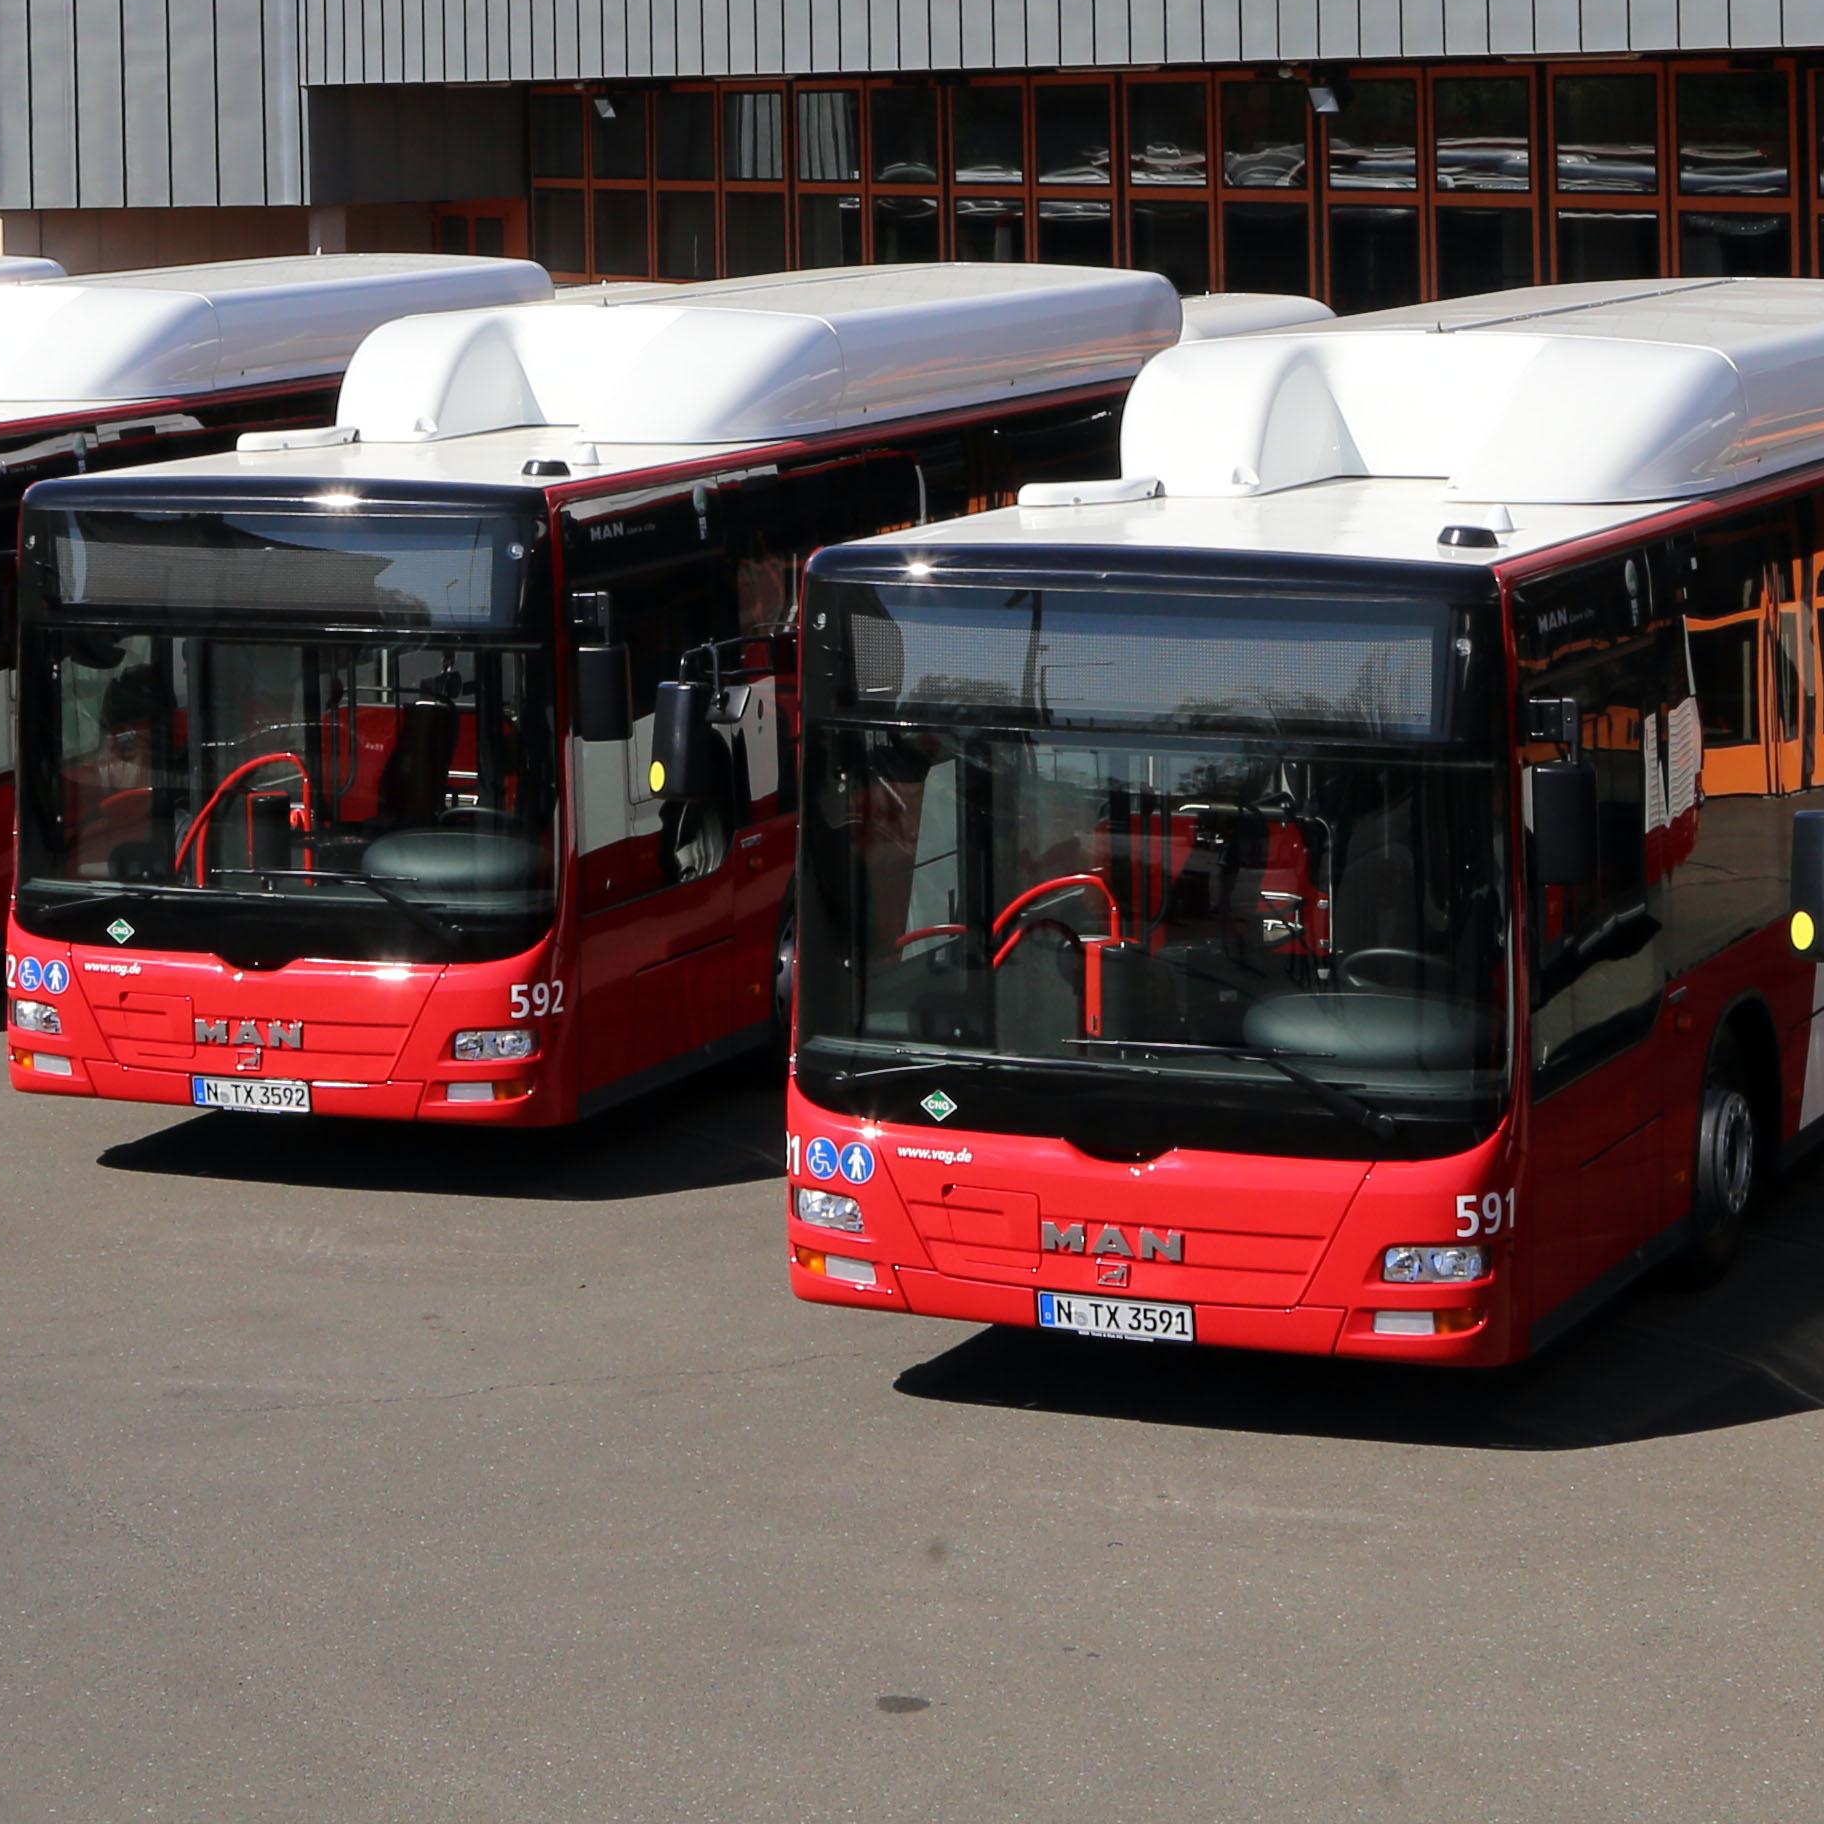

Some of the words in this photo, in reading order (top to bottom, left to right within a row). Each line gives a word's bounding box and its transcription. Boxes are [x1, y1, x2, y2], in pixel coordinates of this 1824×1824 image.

[590, 521, 635, 542] MAN
[1537, 607, 1568, 634] MAN
[83, 961, 143, 977] www.vag.de
[510, 979, 565, 1019] 592
[194, 1018, 303, 1049] MAN
[206, 1082, 219, 1102] N
[230, 1083, 256, 1105] TX
[260, 1086, 307, 1108] 3592
[927, 1102, 950, 1112] CNG
[896, 1146, 974, 1165] www.vag.de
[1455, 1186, 1516, 1239] 591
[1041, 1220, 1186, 1264] MAN
[1056, 1299, 1073, 1324] N
[1088, 1302, 1121, 1330] TX
[1127, 1306, 1190, 1336] 3591
